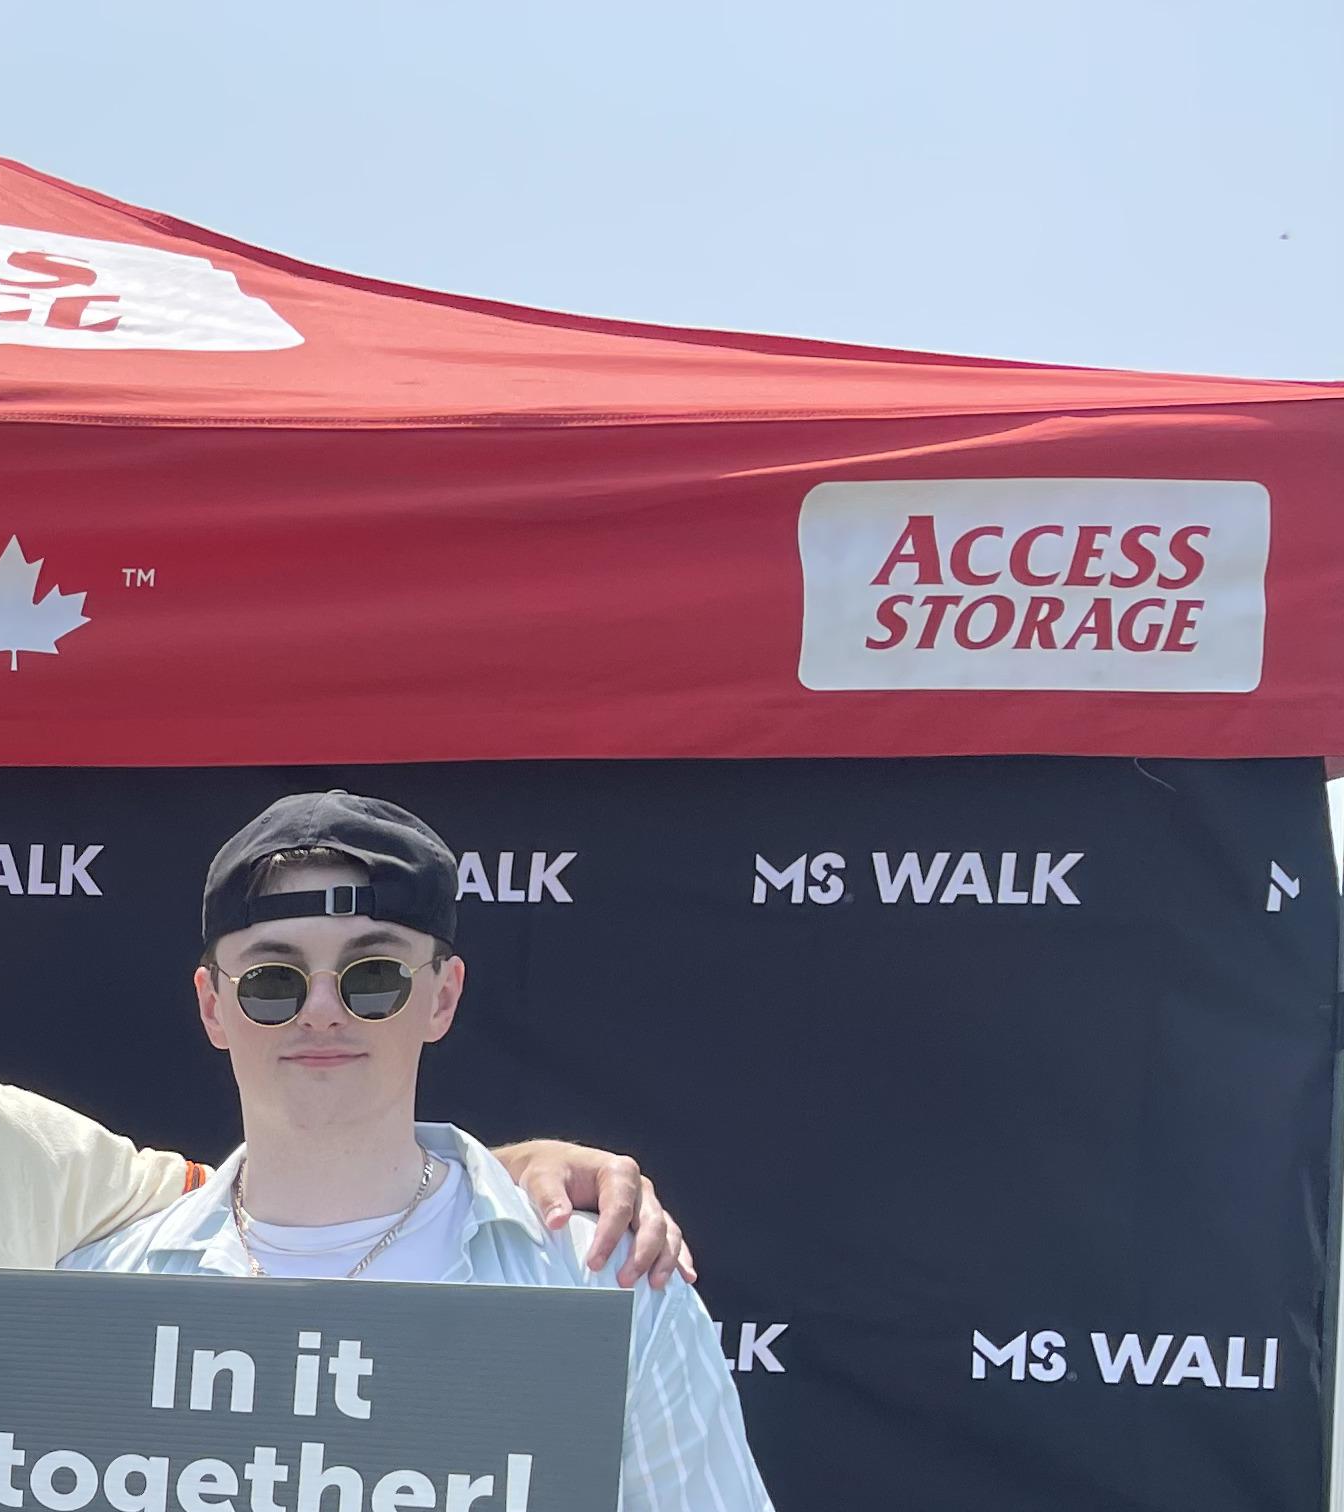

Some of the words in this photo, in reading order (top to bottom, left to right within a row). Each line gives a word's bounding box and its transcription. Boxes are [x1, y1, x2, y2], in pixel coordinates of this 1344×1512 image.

[868, 514, 1212, 590] ACCESS
[864, 594, 1206, 654] STORAGE
[454, 851, 578, 902] ALK
[752, 851, 846, 905] MS
[872, 851, 1085, 905] WALK
[148, 1324, 256, 1413] In
[292, 1330, 375, 1419] it
[971, 1329, 1068, 1382] MS
